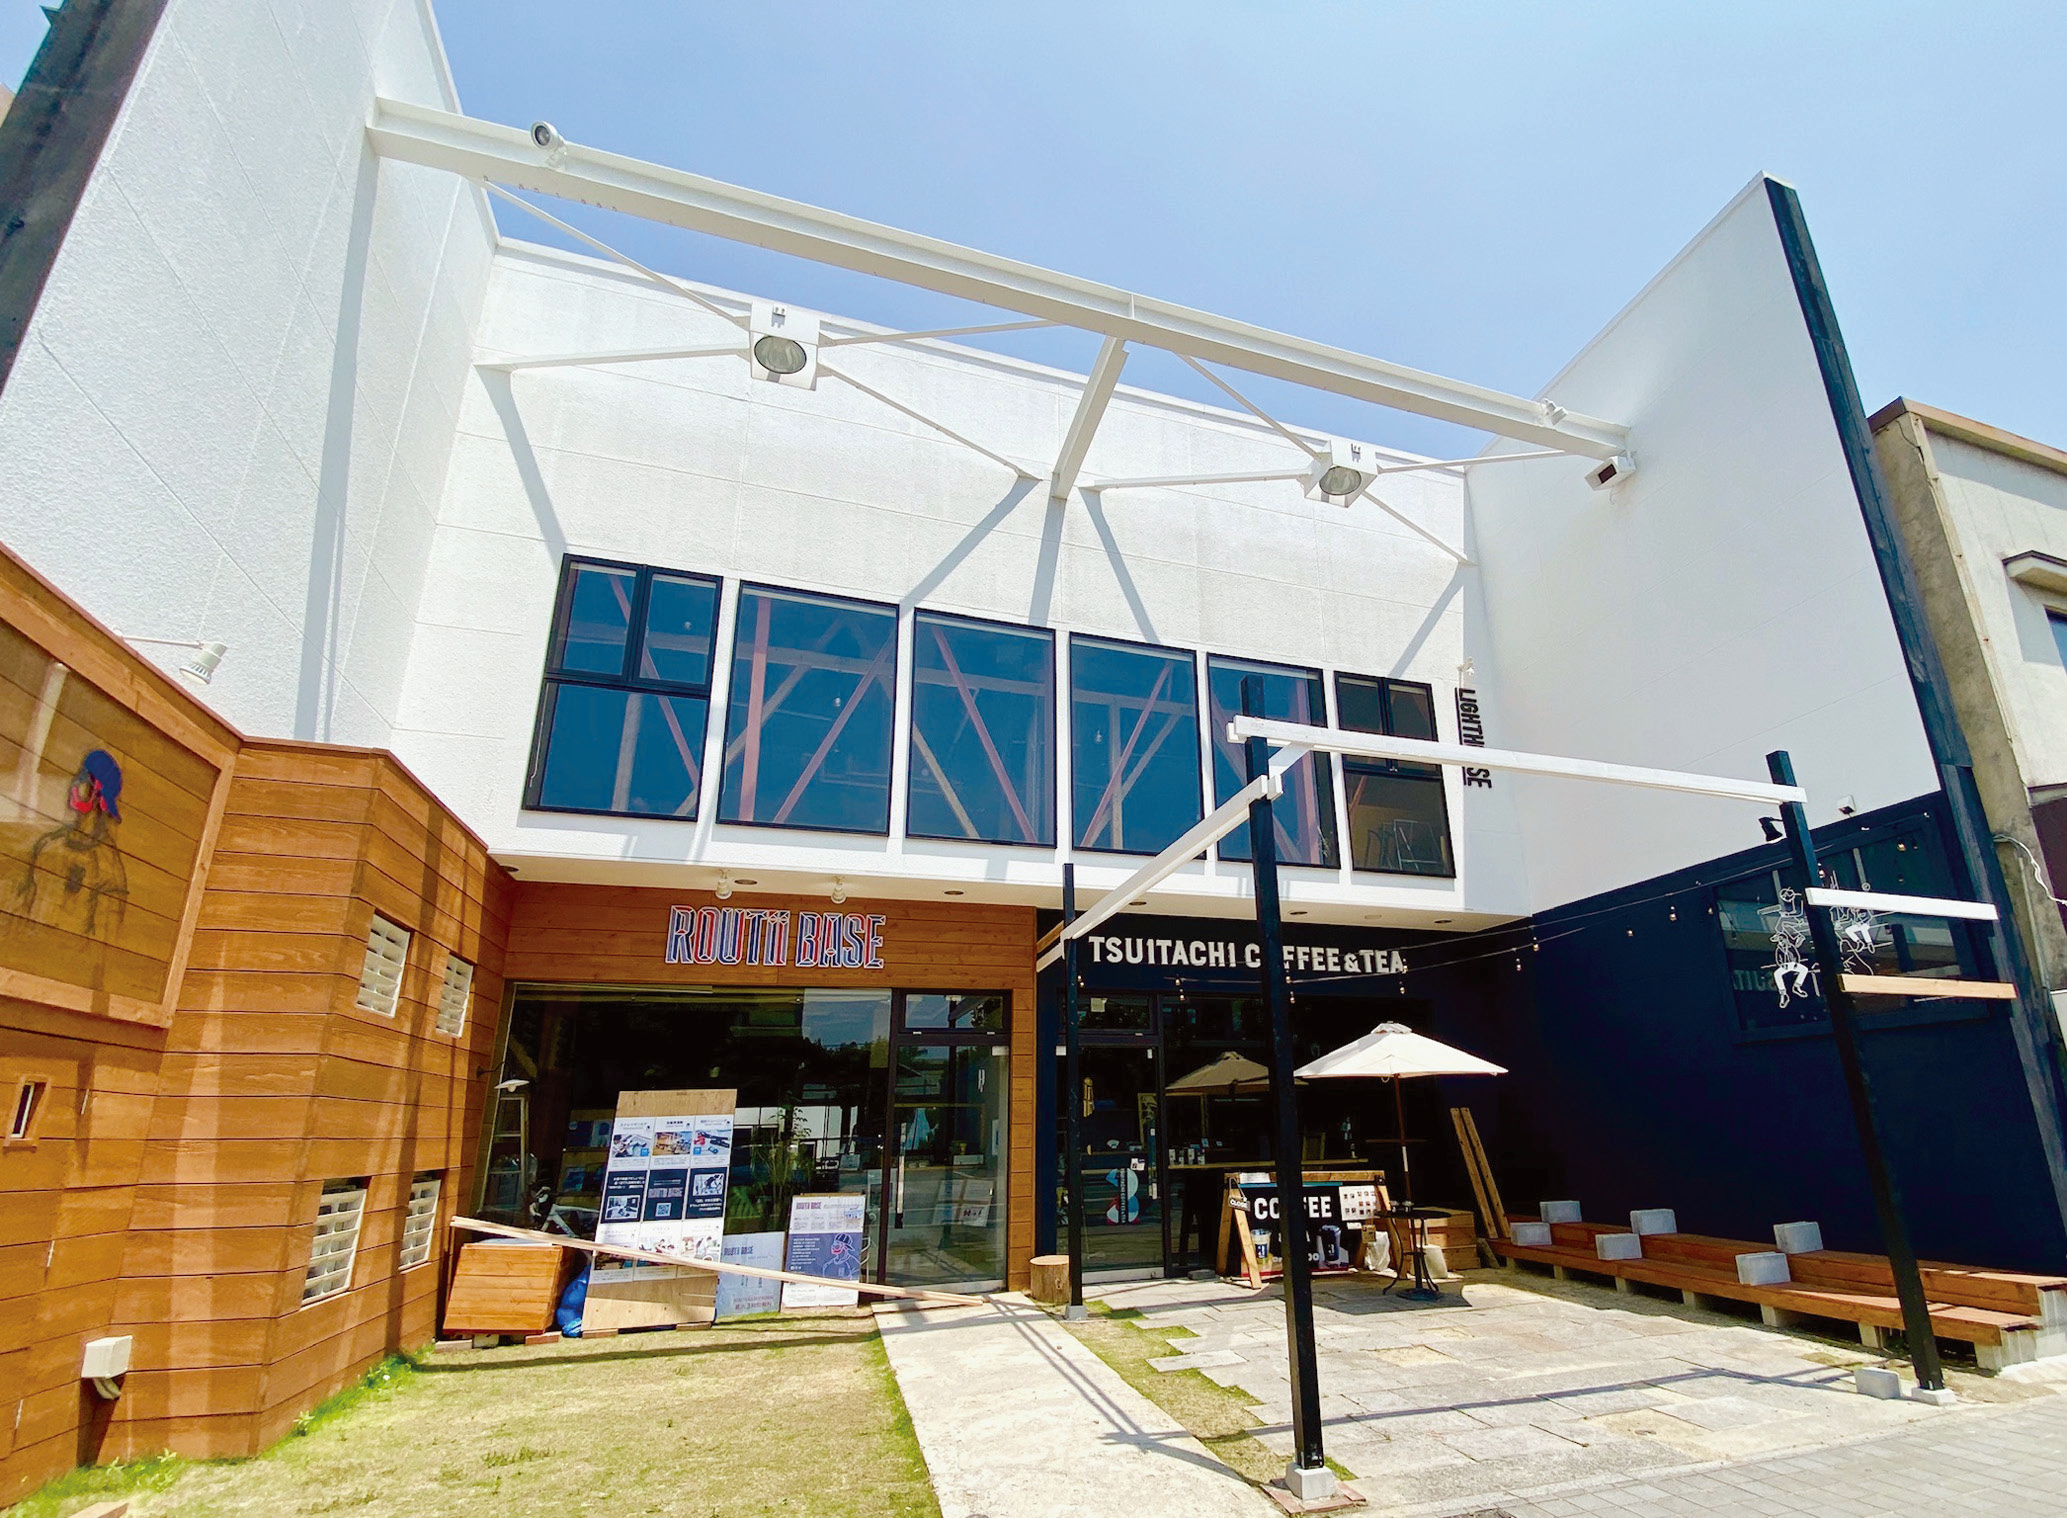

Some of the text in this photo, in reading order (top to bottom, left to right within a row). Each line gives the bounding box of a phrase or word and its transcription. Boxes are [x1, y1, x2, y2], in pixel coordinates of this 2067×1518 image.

[1458, 687, 1492, 788] LIGHTHSE
[795, 911, 886, 969] BASE
[1244, 943, 1404, 973] CFFEE&TEA
[1254, 1196, 1332, 1220] COEE
